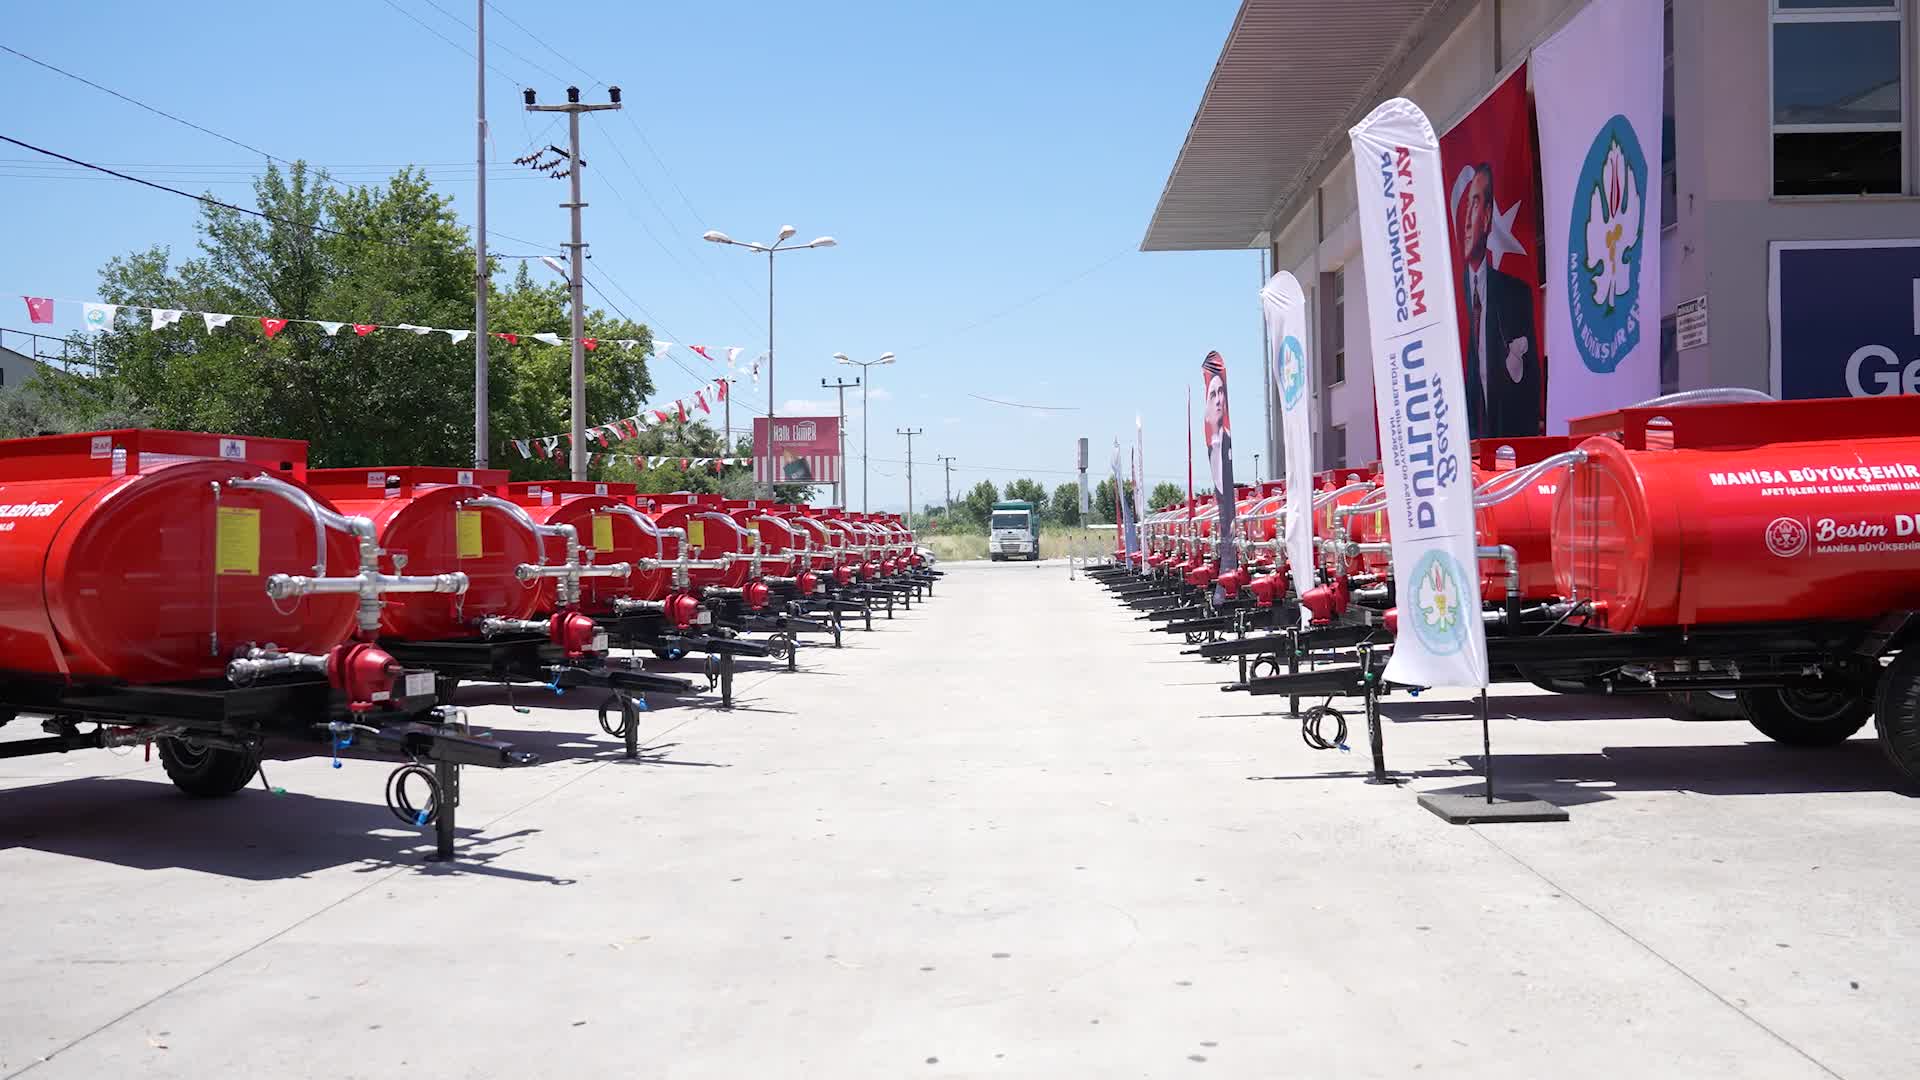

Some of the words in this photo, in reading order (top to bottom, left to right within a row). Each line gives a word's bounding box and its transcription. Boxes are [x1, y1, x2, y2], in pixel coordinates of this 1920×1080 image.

[1709, 469, 1787, 486] MANİSA
[1789, 463, 1920, 483] BÜYÜKŞEHİR
[1761, 487, 1785, 496] AFET
[1786, 485, 1817, 496] İŞLERİ
[1819, 484, 1831, 494] VE
[1833, 483, 1856, 493] RİSK
[1857, 481, 1902, 493] YÖNETİMİ
[1815, 517, 1889, 542] Besim
[1817, 543, 1857, 553] MANİSA
[1858, 541, 1920, 553] BÜYÜKŞEHİR
